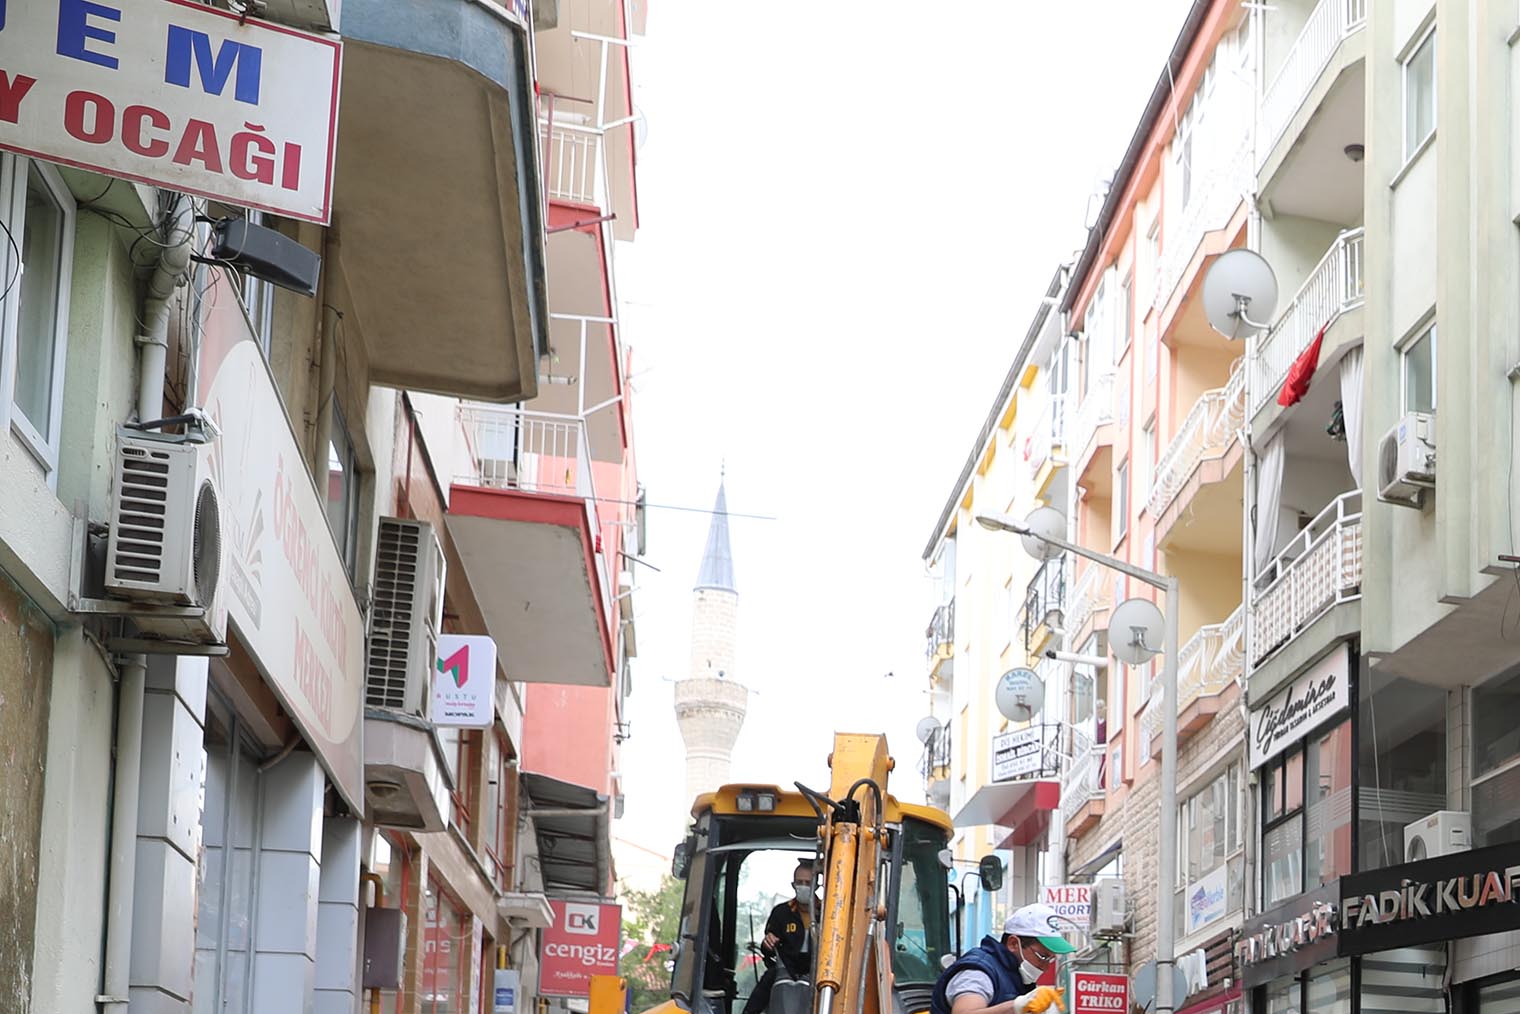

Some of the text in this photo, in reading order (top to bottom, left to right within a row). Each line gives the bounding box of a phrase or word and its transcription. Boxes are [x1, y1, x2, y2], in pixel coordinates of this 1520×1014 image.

[0, 0, 262, 105] EM
[64, 90, 302, 192] OCAĞI
[1341, 878, 1432, 930] FADİK
[544, 941, 616, 966] cengiz
[1077, 979, 1126, 993] Gürkan
[1080, 993, 1123, 1008] TRİKO
